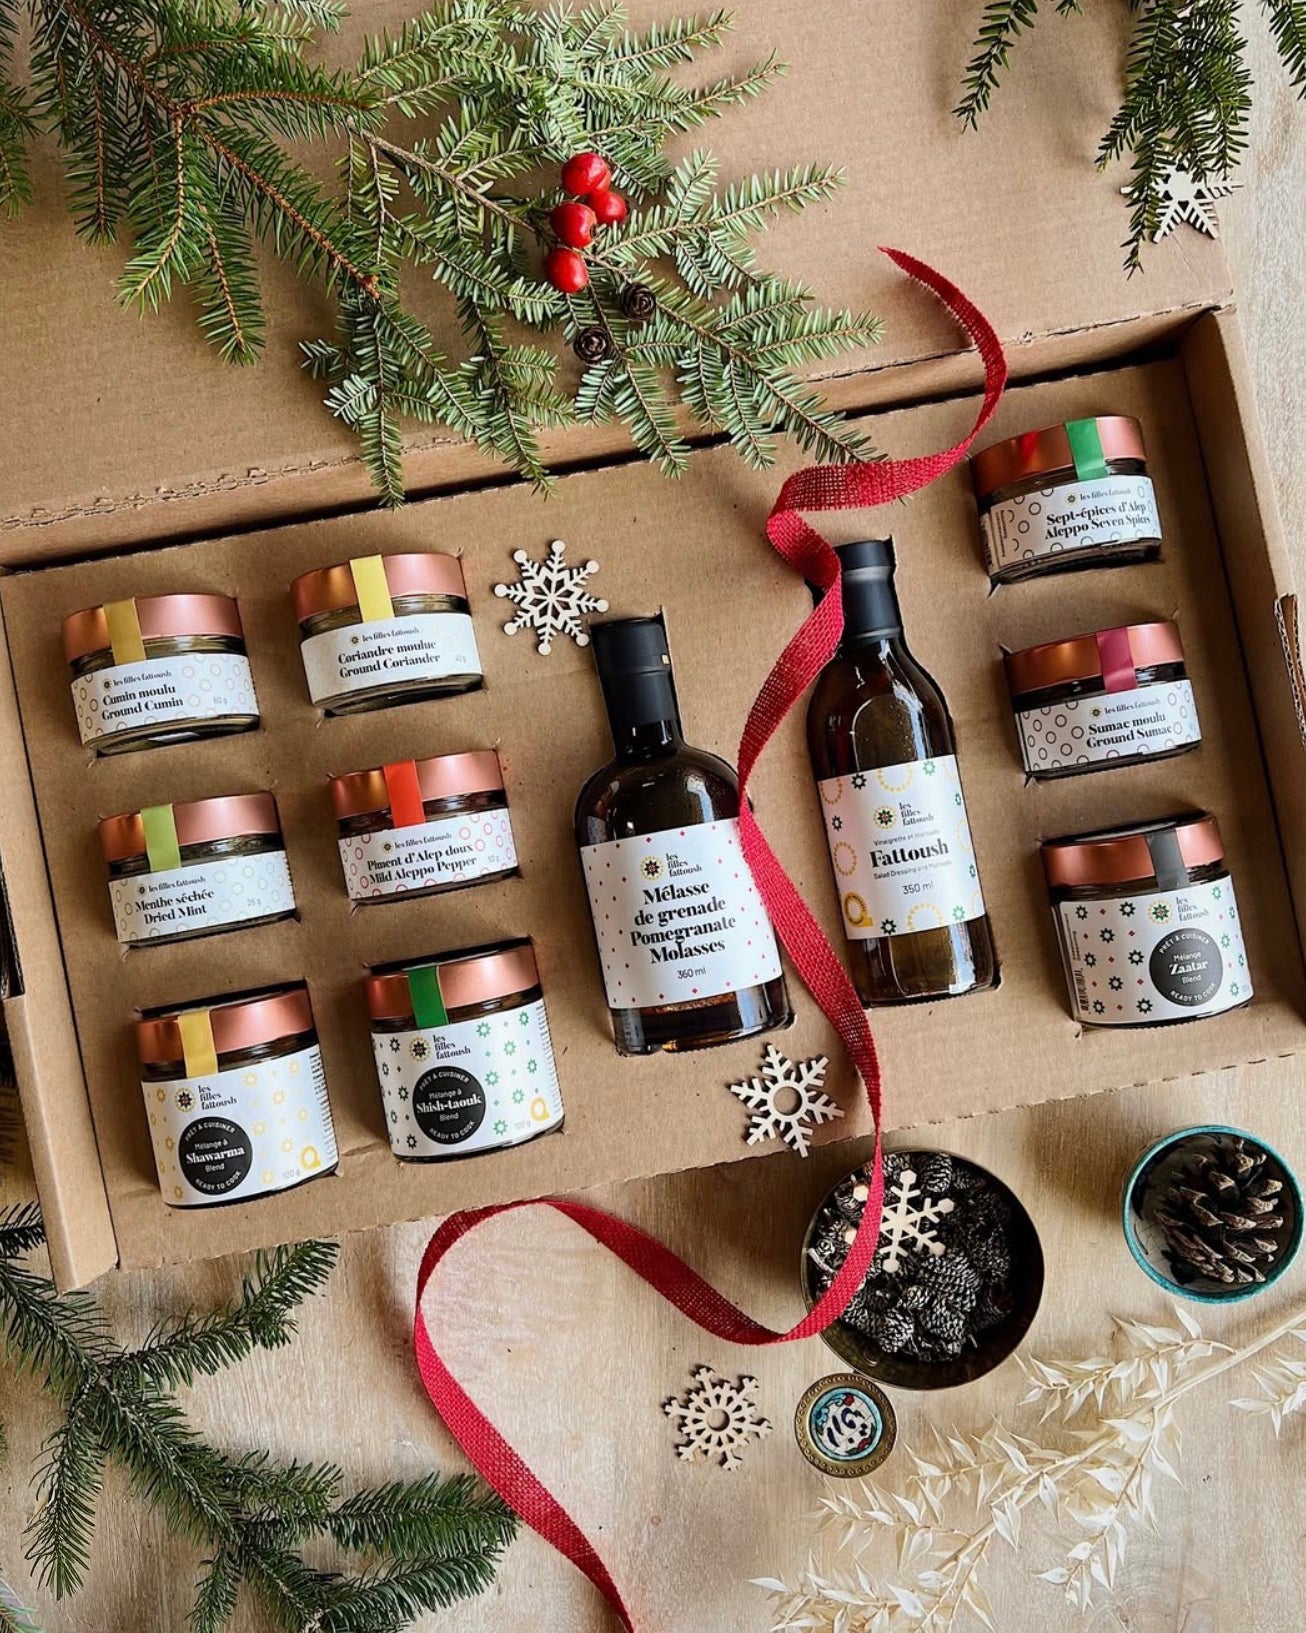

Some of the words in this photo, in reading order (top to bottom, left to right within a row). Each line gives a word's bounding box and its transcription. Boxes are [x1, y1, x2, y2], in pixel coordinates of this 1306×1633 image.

[1080, 493, 1091, 501] les
[1046, 505, 1117, 526] Sept-épices
[1118, 501, 1147, 516] d'Alep
[1044, 523, 1089, 540] Aleppo
[1091, 516, 1124, 530] Seven
[362, 633, 373, 643] les
[373, 631, 391, 640] filles
[338, 646, 395, 665] Coriandre
[396, 639, 437, 654] moulue
[339, 661, 381, 679] Ground
[383, 653, 441, 670] Coriander
[113, 679, 124, 687] les
[123, 675, 141, 685] filles
[102, 691, 137, 707] Cumin
[138, 684, 176, 698] moulu
[102, 703, 142, 721] Ground
[144, 698, 184, 711] Cumin
[1105, 707, 1116, 715] les
[1116, 704, 1134, 713] filles
[1088, 721, 1130, 736] Sumac
[1132, 711, 1166, 728] moulu
[1086, 731, 1135, 748] Ground
[1137, 725, 1173, 740] Sumac
[899, 802, 912, 811] les
[901, 809, 921, 818] filles
[902, 814, 934, 826] fattoush
[394, 841, 406, 850] les
[406, 839, 423, 848] filles
[367, 855, 403, 871] Piment
[404, 850, 443, 864] d'Alep
[445, 844, 474, 857] doux
[666, 853, 678, 861] les
[869, 838, 949, 868] Fattoush
[369, 869, 393, 885] Mild
[394, 866, 435, 881] Aleppo
[437, 857, 477, 873] Pepper
[667, 860, 689, 869] filles
[669, 864, 703, 877] fattoush
[874, 869, 890, 880] Salad
[891, 866, 917, 877] Dressing
[148, 884, 158, 893] les
[158, 880, 176, 891] filles
[902, 884, 921, 895] 350
[922, 880, 934, 891] ml
[643, 882, 710, 905] Mélasse
[135, 896, 174, 913] Menthe
[175, 889, 215, 904] séchée
[1176, 896, 1188, 906] les
[144, 907, 176, 925] Dried
[178, 904, 208, 919] Mint
[634, 910, 655, 926] de
[658, 896, 726, 927] grenade
[1177, 903, 1198, 913] filles
[1179, 908, 1210, 922] fattoush
[630, 916, 736, 947] Pomegranate
[650, 939, 726, 964] Molasses
[1173, 951, 1201, 962] Mélange
[677, 968, 694, 980] 360
[695, 967, 707, 976] ml
[1169, 960, 1209, 976] Zaatar
[1181, 973, 1202, 984] Blend
[1170, 990, 1192, 1002] READY
[1193, 994, 1203, 1002] TO
[433, 1034, 446, 1042] les
[434, 1042, 456, 1051] filles
[436, 1046, 471, 1060] fattoush
[198, 1085, 211, 1093] les
[428, 1090, 456, 1099] Mélange
[199, 1093, 222, 1102] filles
[201, 1096, 238, 1111] fattoush
[416, 1094, 483, 1114] Shish-taouk
[439, 1112, 459, 1122] Blend
[429, 1127, 449, 1140] READY
[451, 1132, 460, 1140] TO
[194, 1140, 221, 1151] Mélange
[185, 1146, 245, 1165] Shawarma
[205, 1162, 225, 1173] Blend
[195, 1178, 215, 1191] READY
[227, 1170, 242, 1187] COOK
